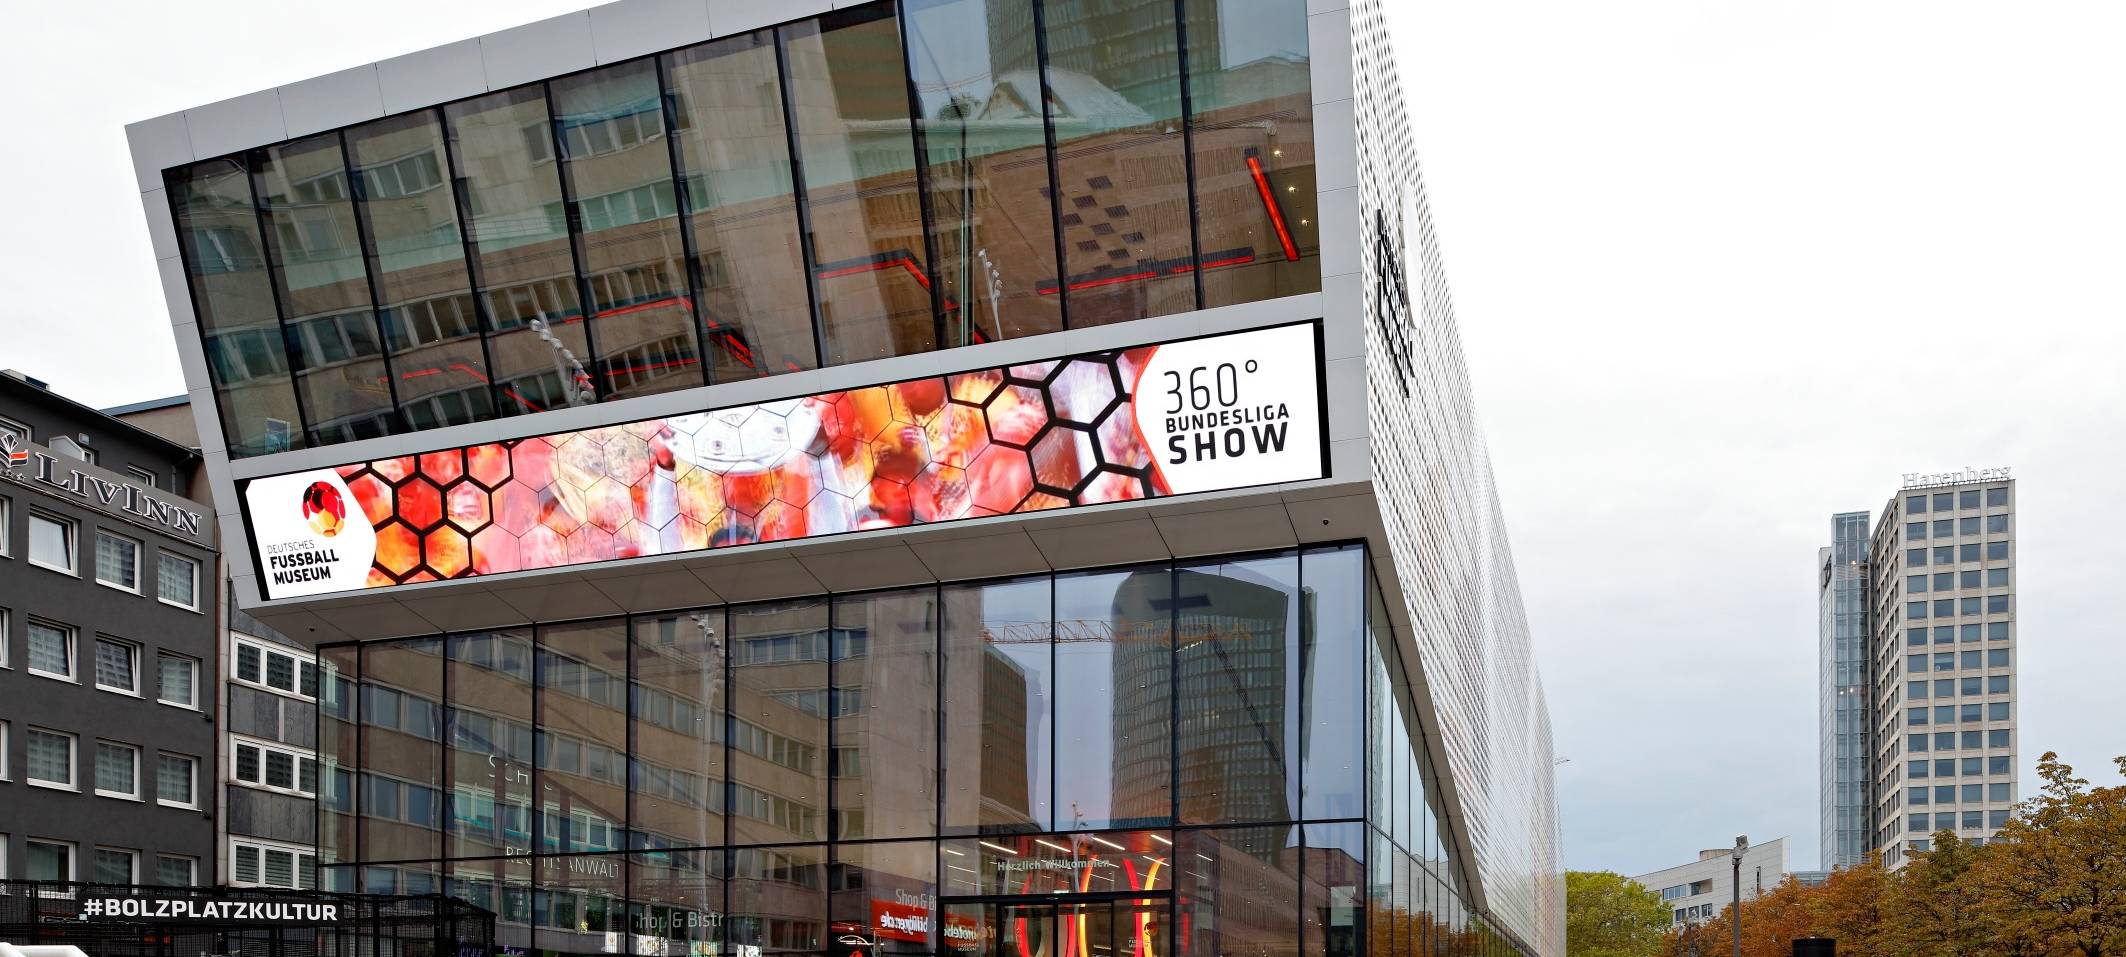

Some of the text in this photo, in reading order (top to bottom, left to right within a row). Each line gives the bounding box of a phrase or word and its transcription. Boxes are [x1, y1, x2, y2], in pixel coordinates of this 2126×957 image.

[1164, 359, 1258, 415] 360°
[1166, 403, 1289, 433] BUNDESLIGA
[1168, 421, 1288, 465] SHOW
[1902, 465, 2012, 488] Harenberg
[266, 540, 315, 554] DEUTSCHES
[270, 549, 340, 570] FUSSBALL
[273, 566, 331, 585] MUSEUM
[997, 858, 1110, 872] Herzlich Willkommen
[84, 898, 338, 922] #BOLZPLATZKULTUR
[895, 888, 918, 911] Shop
[921, 893, 928, 909] &
[636, 912, 667, 932] hop
[672, 912, 683, 928] &
